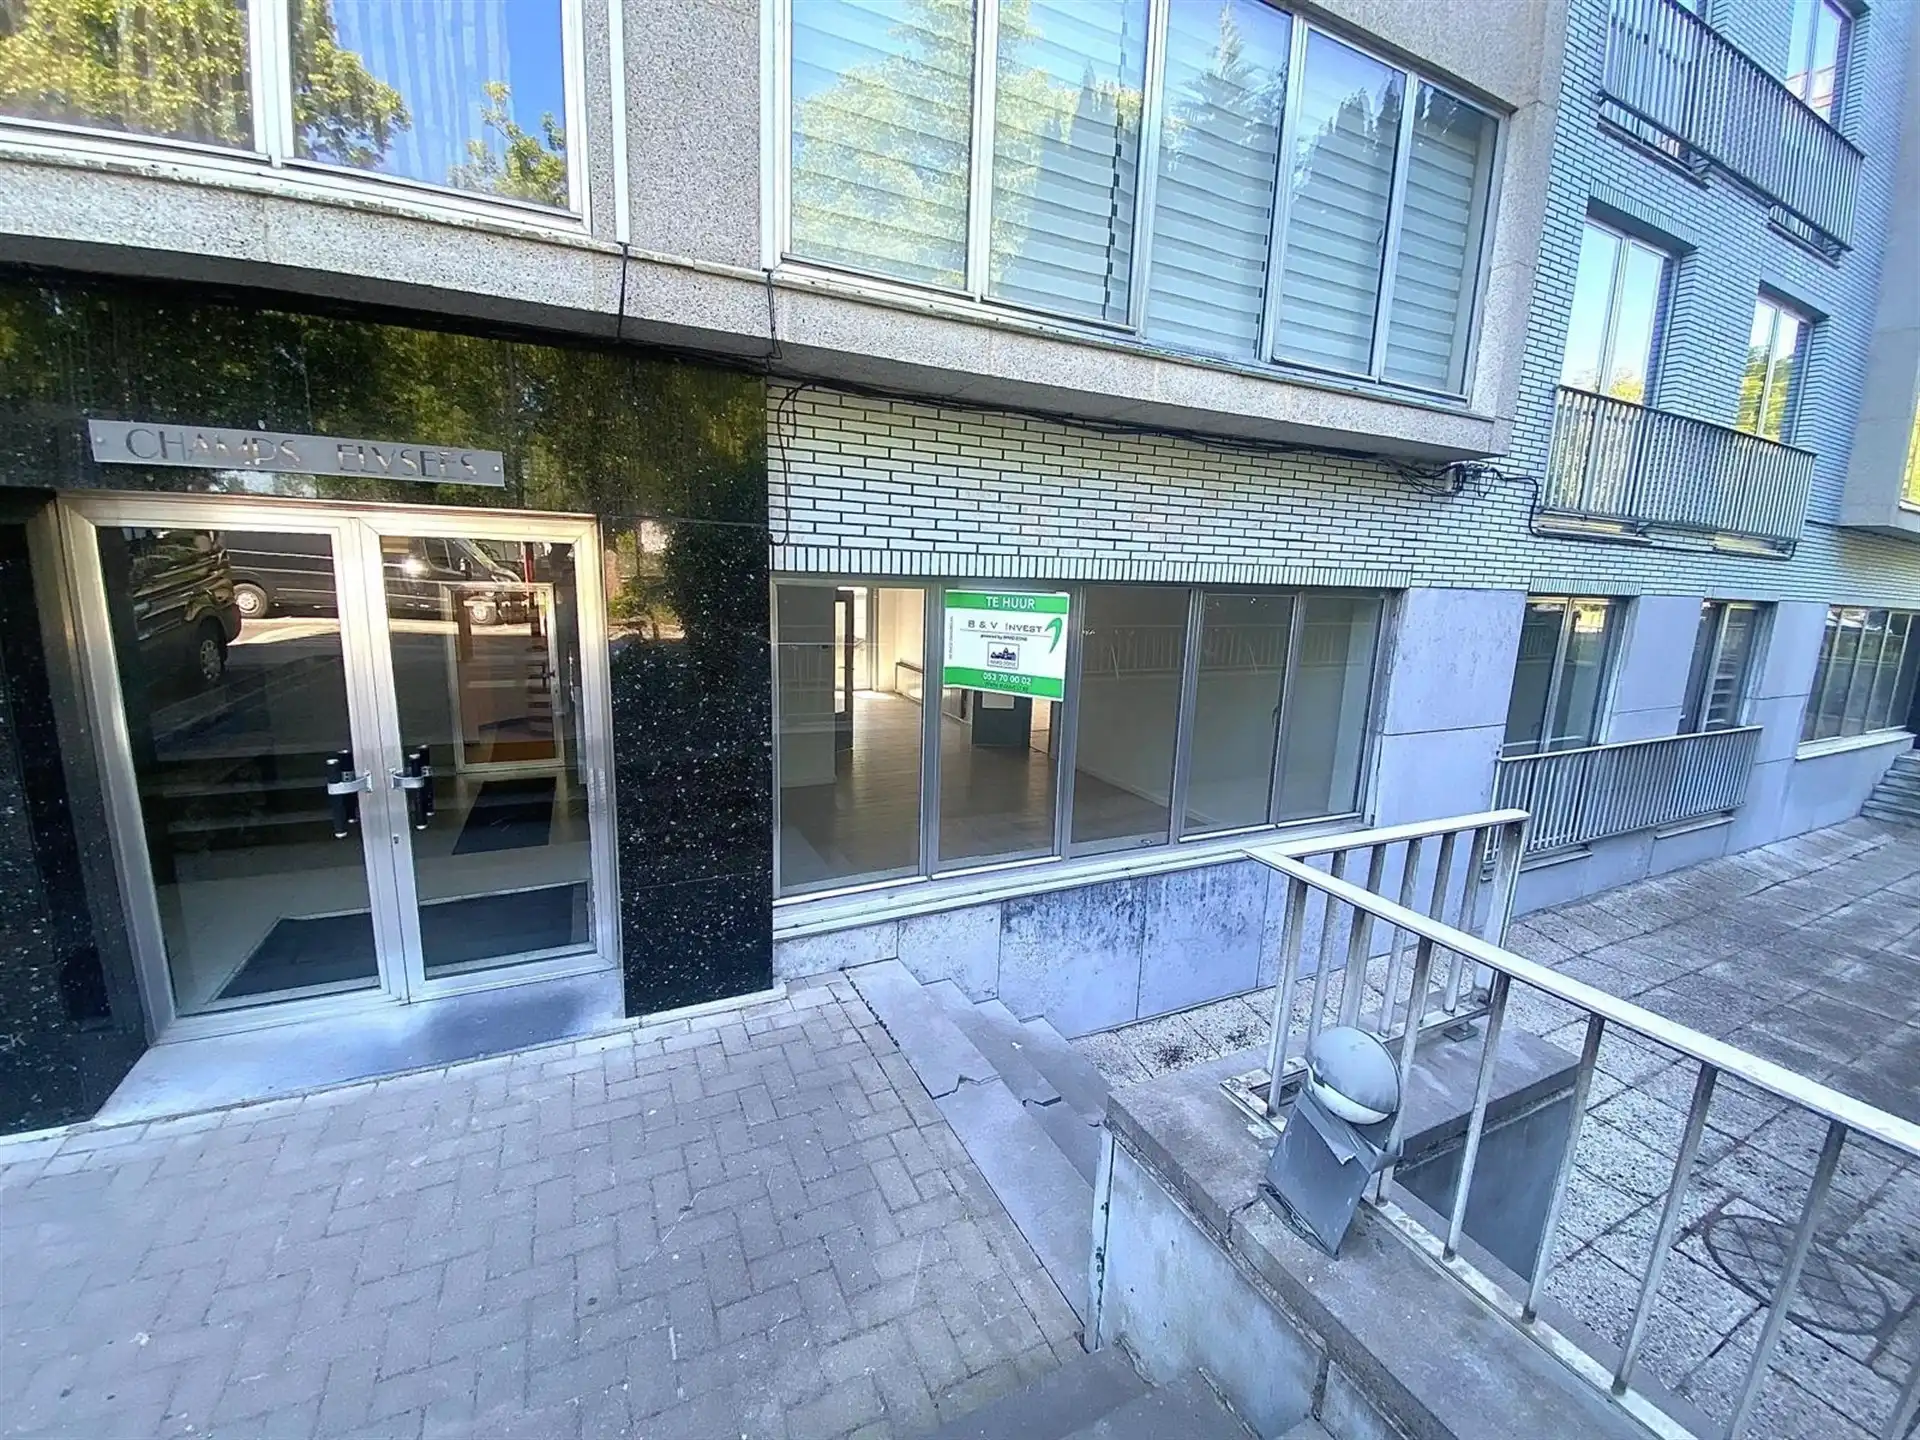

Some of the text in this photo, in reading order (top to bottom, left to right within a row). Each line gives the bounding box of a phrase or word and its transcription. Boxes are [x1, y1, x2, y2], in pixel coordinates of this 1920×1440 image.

[125, 428, 302, 468] CHAMPS
[985, 596, 1035, 610] TE HUUR
[968, 620, 976, 628] B
[979, 621, 987, 629] &
[990, 622, 998, 630] V
[998, 673, 1008, 682] 70
[1010, 675, 1020, 684] 00
[1021, 676, 1031, 685] 02
